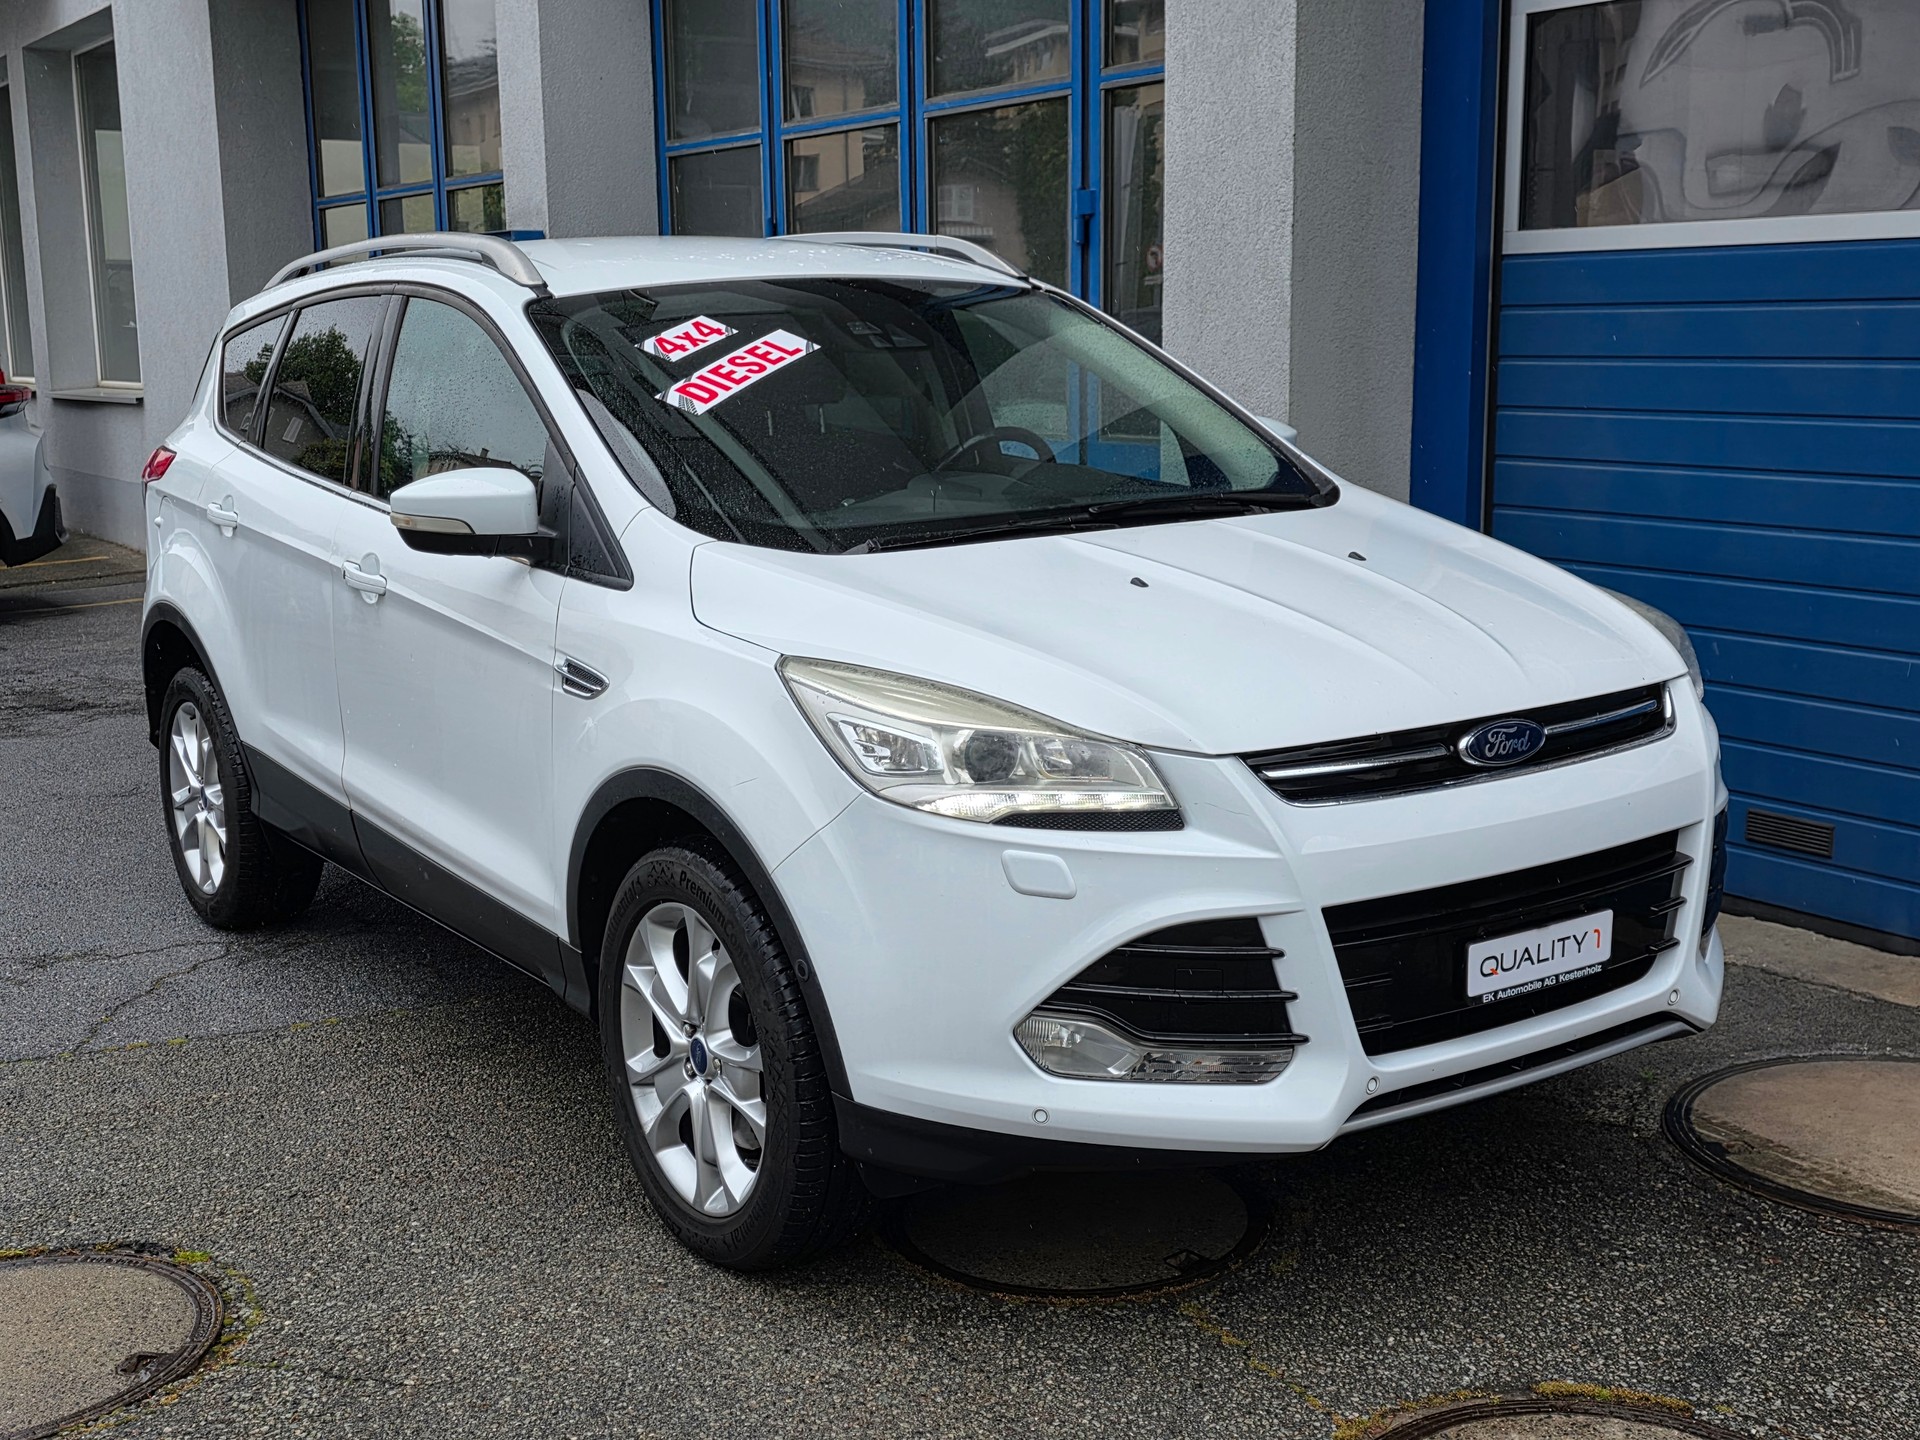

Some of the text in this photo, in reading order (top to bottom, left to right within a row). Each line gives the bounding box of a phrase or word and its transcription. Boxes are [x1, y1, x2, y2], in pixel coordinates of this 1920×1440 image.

[654, 320, 726, 355] 4x4
[674, 340, 804, 405] DIESEL
[1485, 726, 1531, 758] Ford
[1483, 964, 1602, 1003] EK Automobile AG Kestenholz
